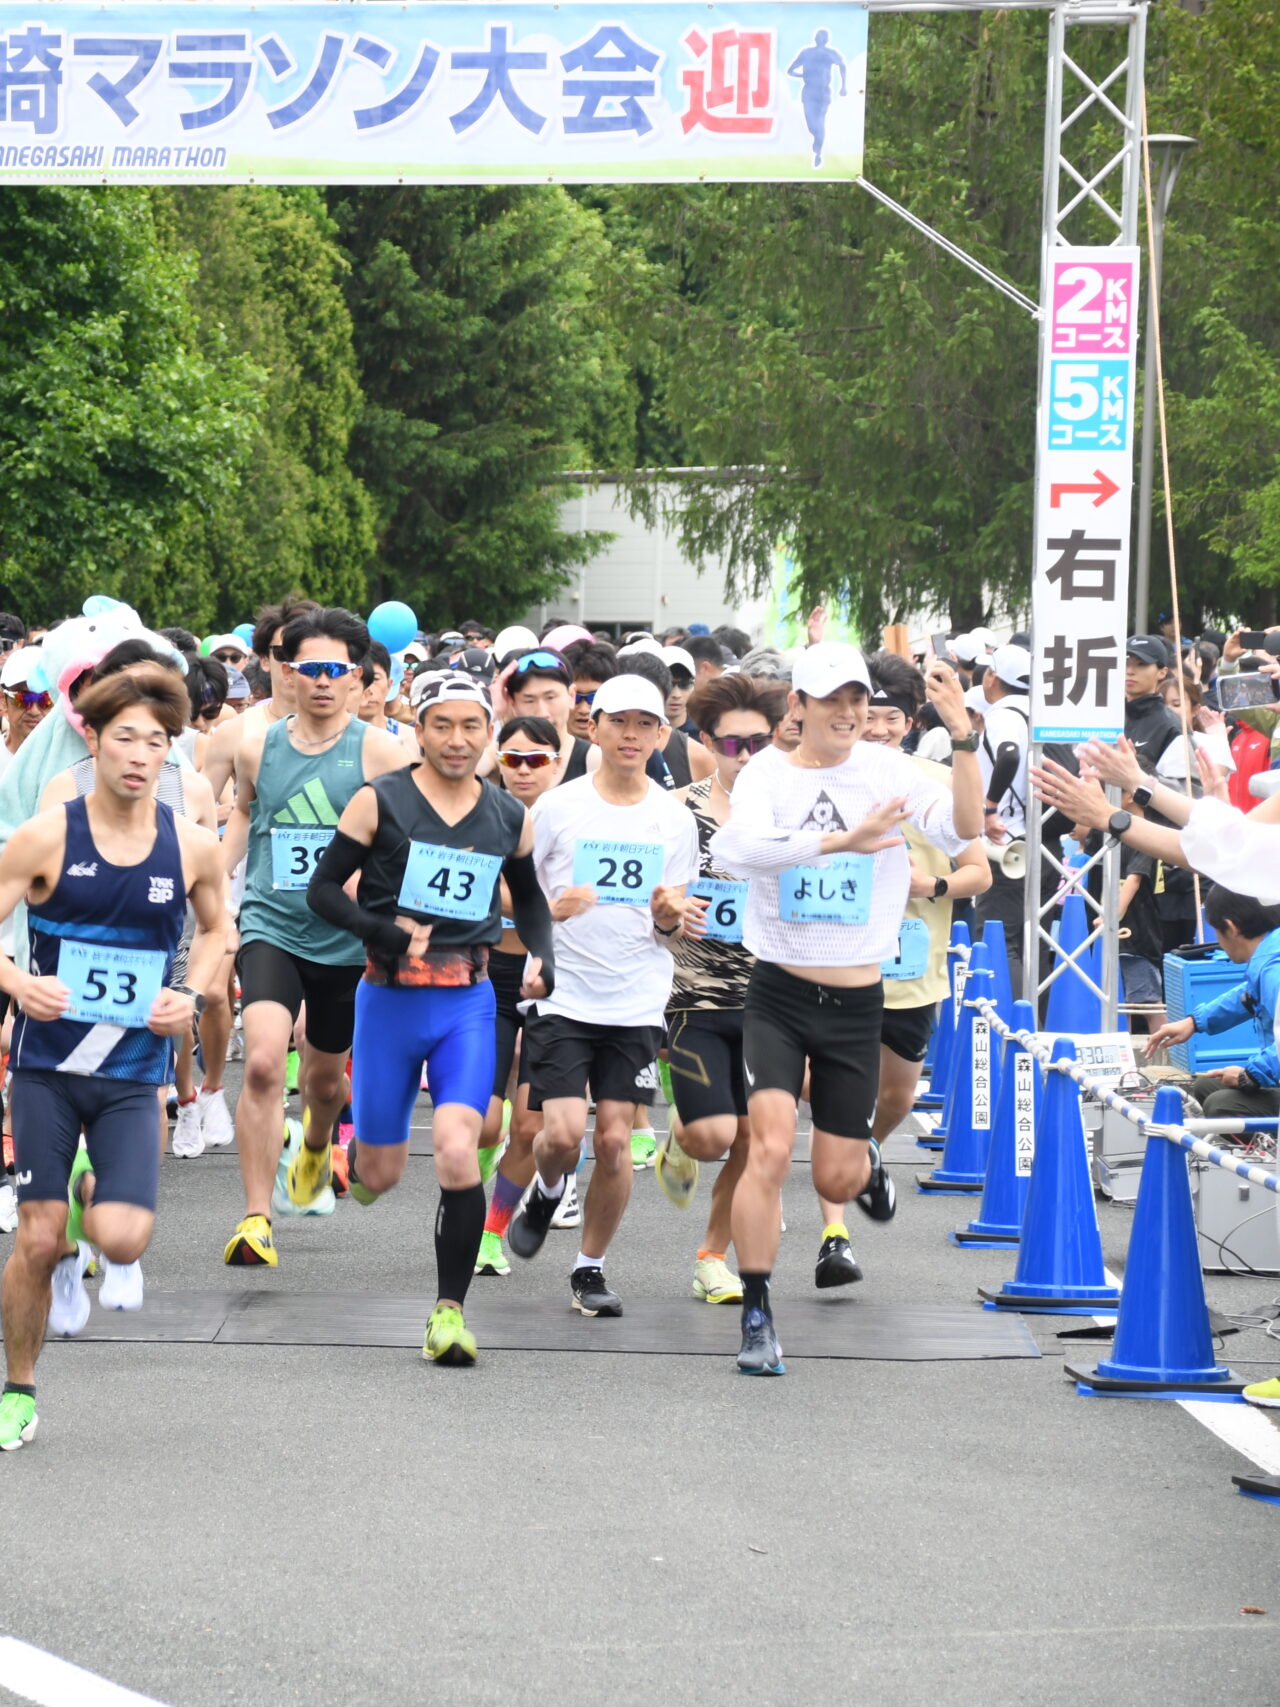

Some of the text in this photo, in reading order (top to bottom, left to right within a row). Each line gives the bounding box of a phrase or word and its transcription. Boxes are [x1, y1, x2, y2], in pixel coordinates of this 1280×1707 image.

[111, 147, 227, 168] MARATHON
[1055, 327, 1126, 349] コース
[1051, 424, 1123, 446] コース
[293, 832, 336, 841] 岩手朝日テ
[427, 867, 476, 902] 43
[596, 857, 644, 890] 28
[793, 877, 859, 902] よしき
[82, 968, 138, 1006] 53
[973, 1021, 989, 1125] 森山総合公園
[1016, 1057, 1034, 1172] 森山総合公園
